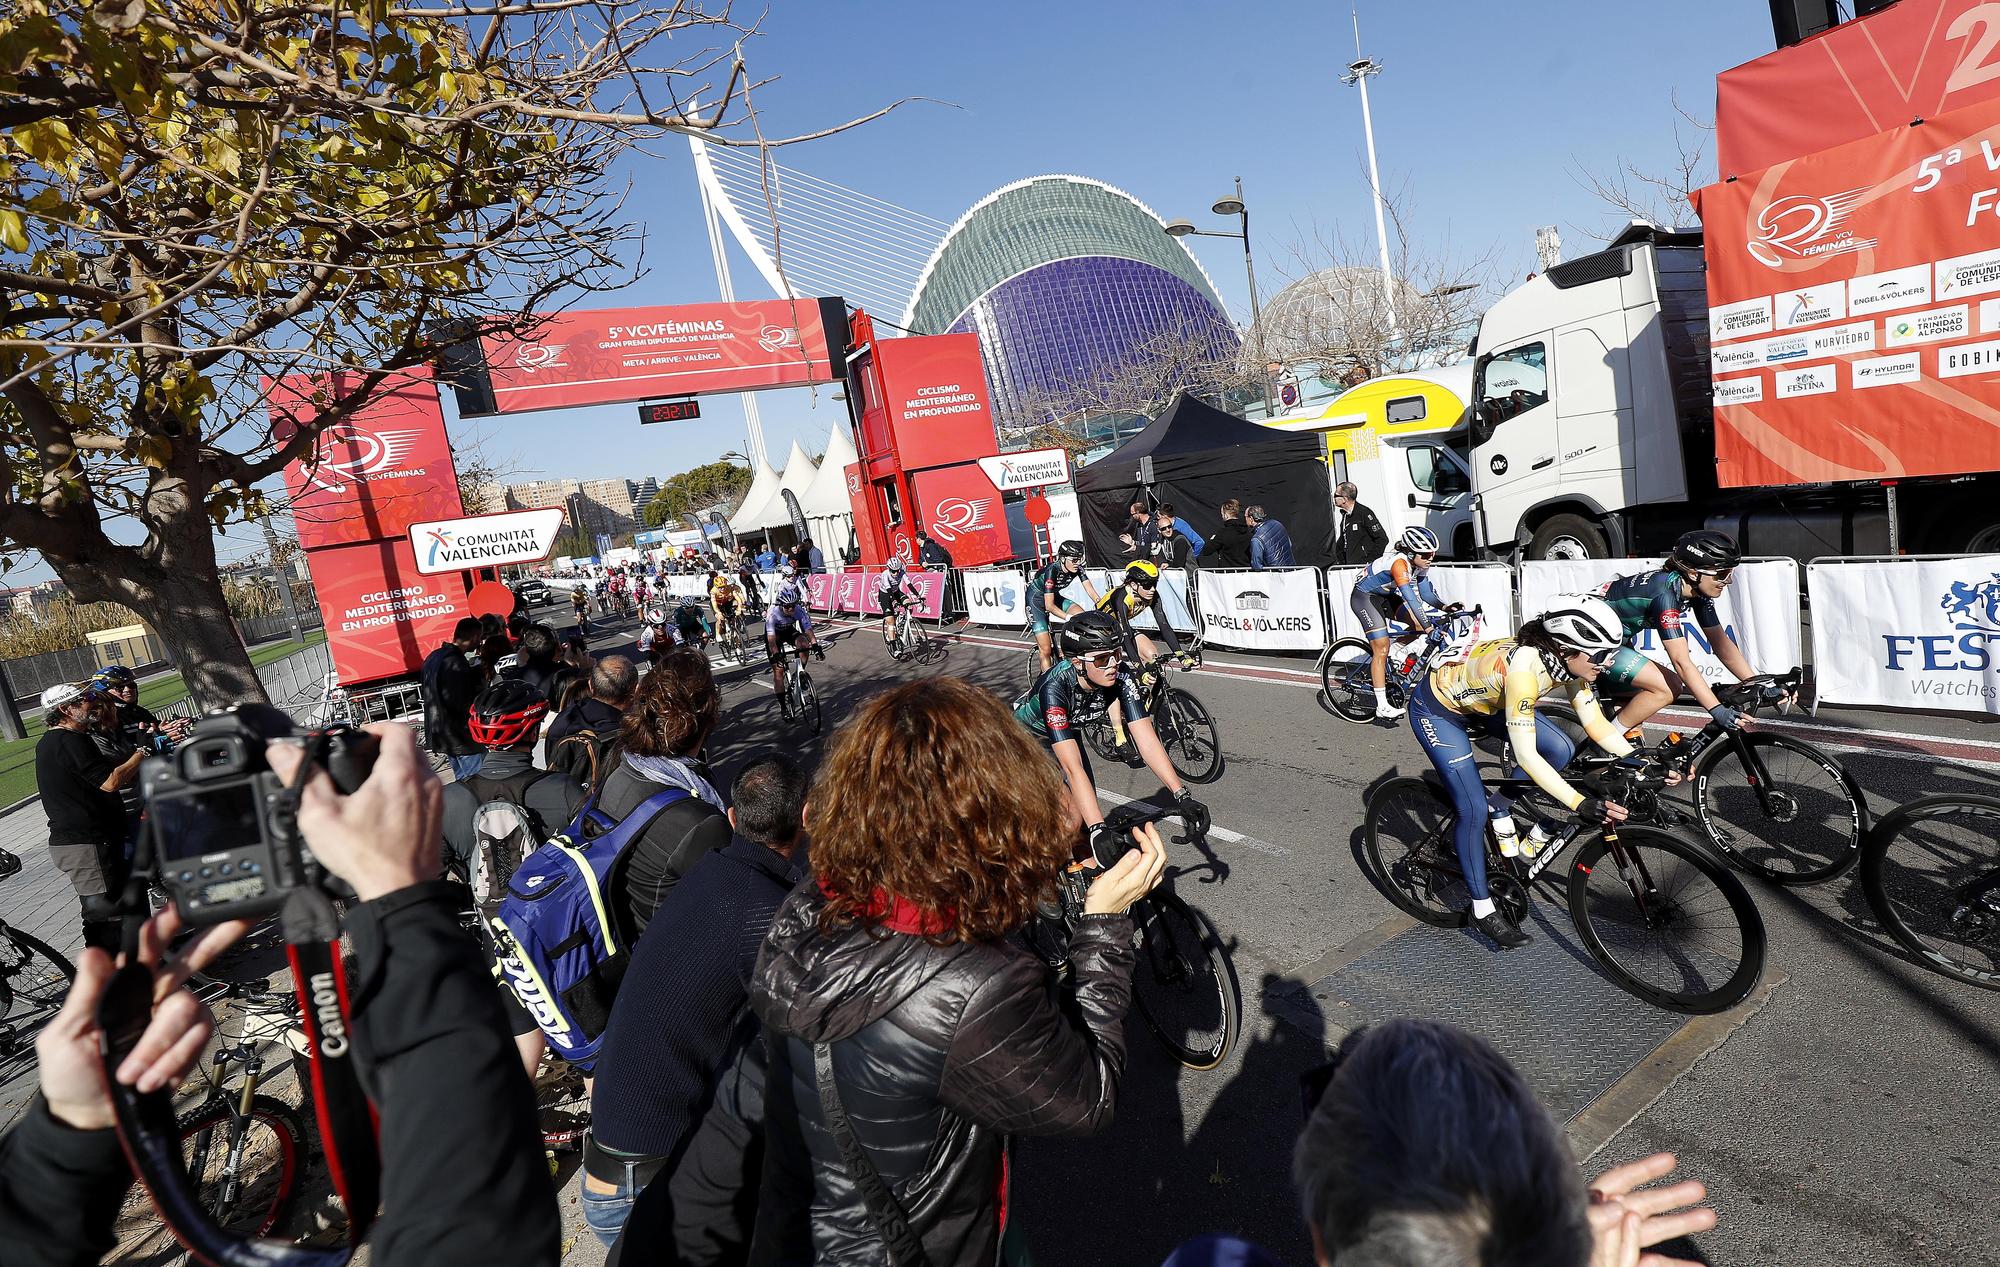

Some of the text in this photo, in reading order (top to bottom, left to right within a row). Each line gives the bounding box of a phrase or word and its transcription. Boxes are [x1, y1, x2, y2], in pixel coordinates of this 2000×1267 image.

[1966, 188, 2000, 226] F
[1836, 231, 1853, 240] VCV
[1803, 239, 1854, 257] FÉMINAS
[1956, 263, 1984, 272] Comunitat
[1960, 278, 1973, 287] DE
[1723, 311, 1765, 324] COMUNITAT
[1795, 313, 1831, 323] VALENCIANA
[1796, 308, 1830, 318] COMUNITAT
[625, 320, 724, 338] VCVFÉMINAS
[1726, 316, 1770, 330] DE L'ESPORT
[1918, 318, 1963, 330] TRINIDAD
[1918, 325, 1963, 336] ALFONSO
[599, 341, 622, 349] GRAN
[648, 335, 688, 346] DIPUTACIÓ
[699, 332, 735, 341] VALÈNCIA
[1815, 331, 1870, 349] MURVIEDRO
[651, 355, 681, 365] ARRIVE:
[683, 352, 721, 362] VALÈNCIA
[1719, 350, 1754, 363] València
[1875, 363, 1915, 374] HYUNDAI
[917, 384, 960, 396] CICLISMO
[1720, 385, 1754, 397] València
[1787, 381, 1825, 392] FESTINA
[906, 392, 976, 409] MEDITERRÁNEO
[1742, 393, 1760, 401] esports
[904, 402, 981, 419] EN PROFUNDIDAD
[1564, 449, 1583, 460] 500
[1016, 461, 1061, 473] COMUNITAT
[1008, 469, 1064, 484] VALENCIANA
[457, 528, 536, 547] COMUNITAT
[440, 540, 540, 562] VALENCIANA
[361, 586, 423, 603] CICLISMO
[972, 587, 999, 607] UCI
[345, 594, 447, 619] MEDITERRÁNEO
[341, 604, 455, 632] EN PROFUNDIDAD
[1911, 679, 1997, 698] Watches
[47, 691, 73, 705] Renault
[1420, 718, 1441, 748] etixx
[309, 971, 350, 1059] Canon
